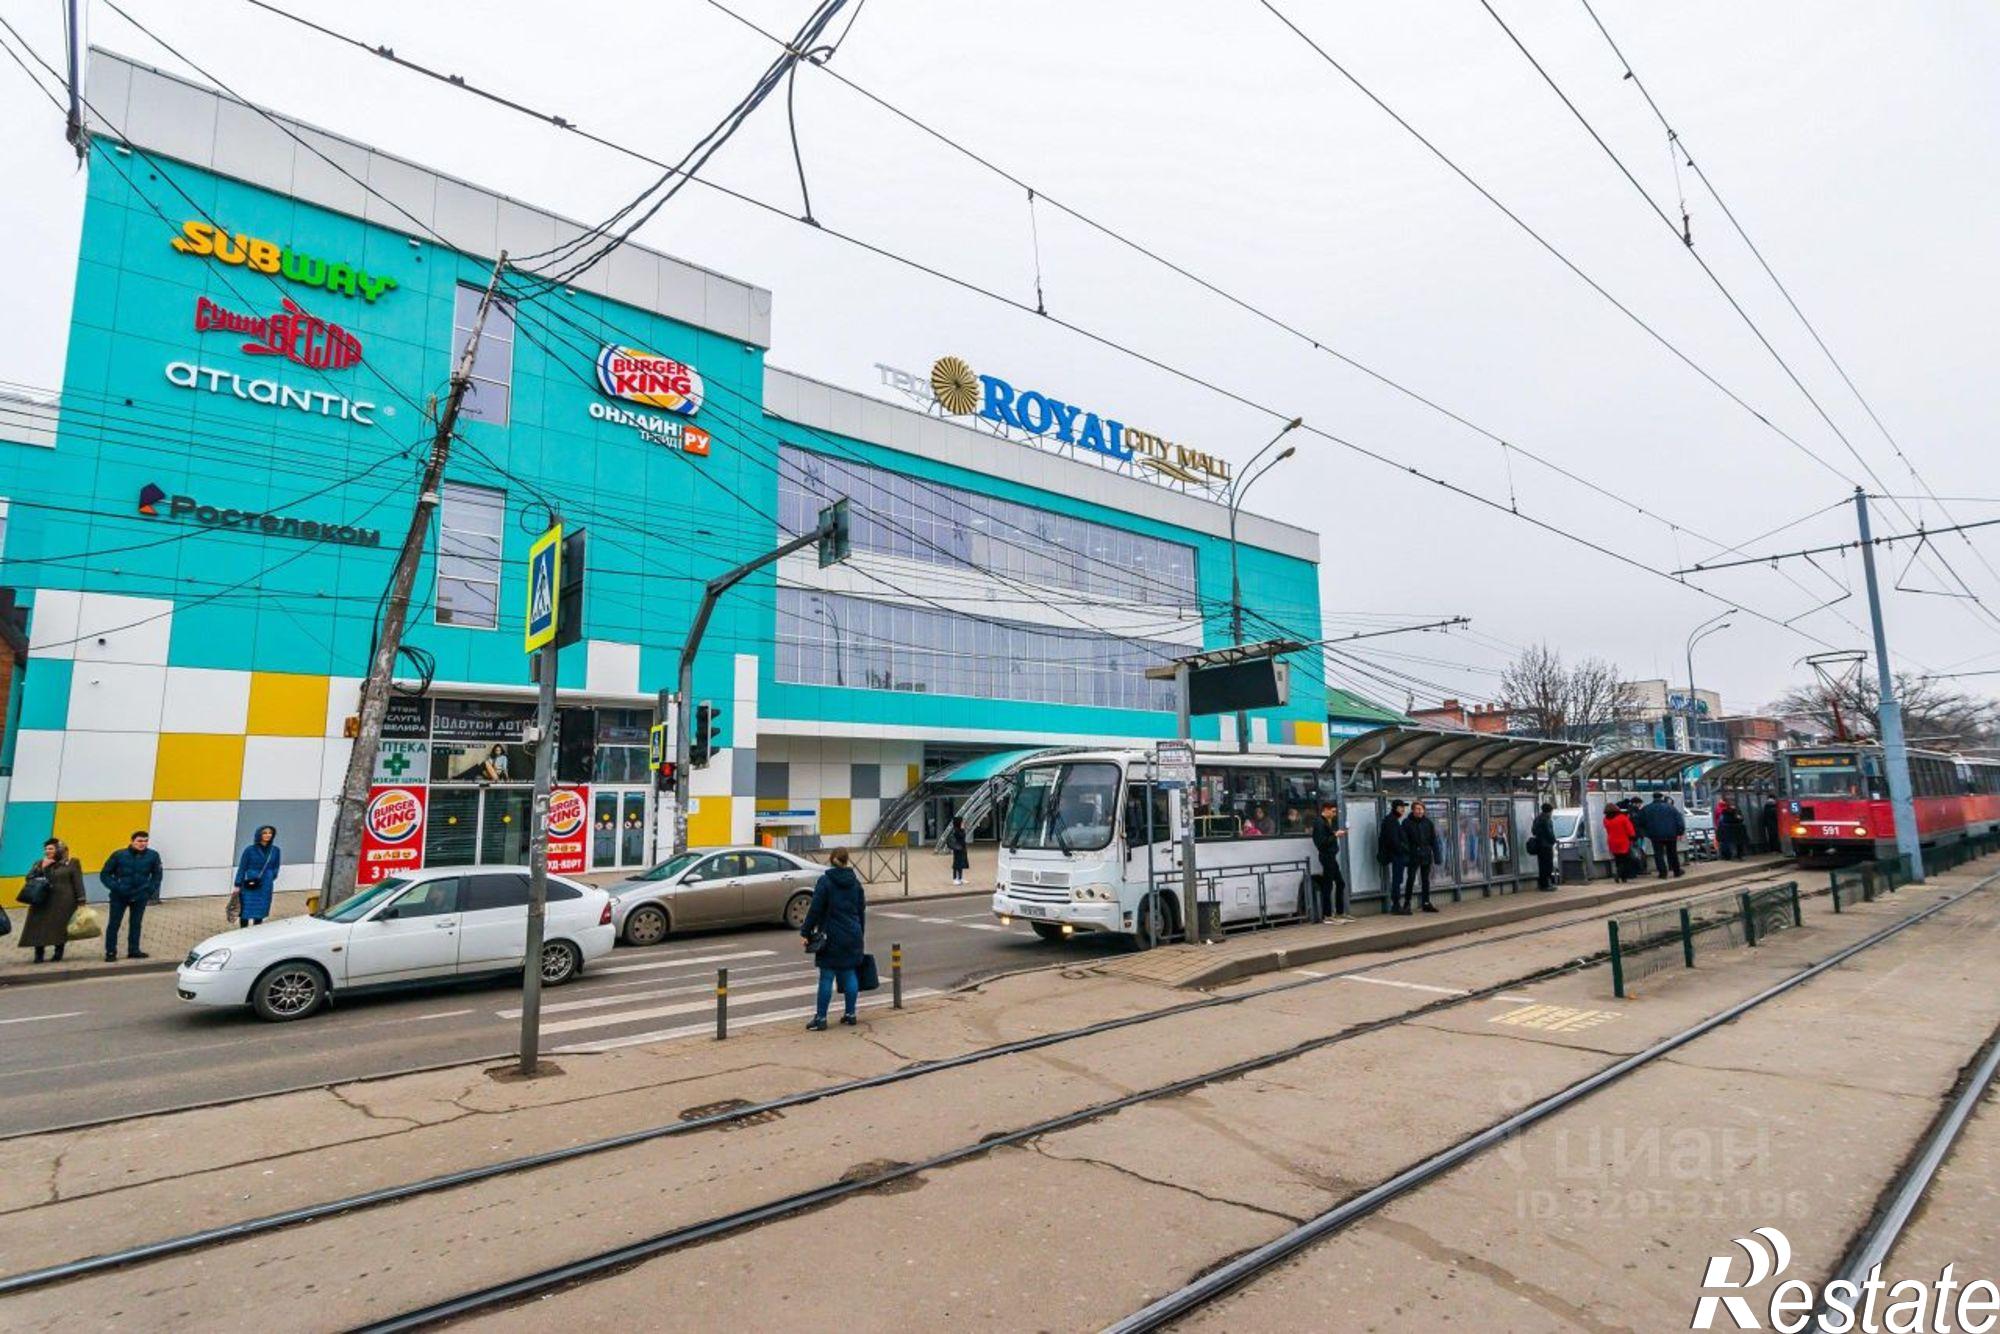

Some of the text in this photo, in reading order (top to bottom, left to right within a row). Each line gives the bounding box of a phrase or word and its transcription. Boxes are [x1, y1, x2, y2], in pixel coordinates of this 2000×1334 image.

[171, 220, 397, 303] SUBWAY
[613, 358, 689, 377] BURGER
[616, 374, 691, 395] KING
[588, 401, 677, 437] ОНЛАЙН
[978, 374, 1133, 462] ROYAL
[1124, 426, 1229, 480] CITY MALL
[170, 494, 381, 548] Ростелеком
[386, 714, 422, 723] СЛУГИ
[373, 800, 415, 820] BURGER
[1791, 802, 1799, 812] 5
[373, 808, 417, 832] KING
[1822, 826, 1840, 836] 591
[371, 865, 380, 879] 3
